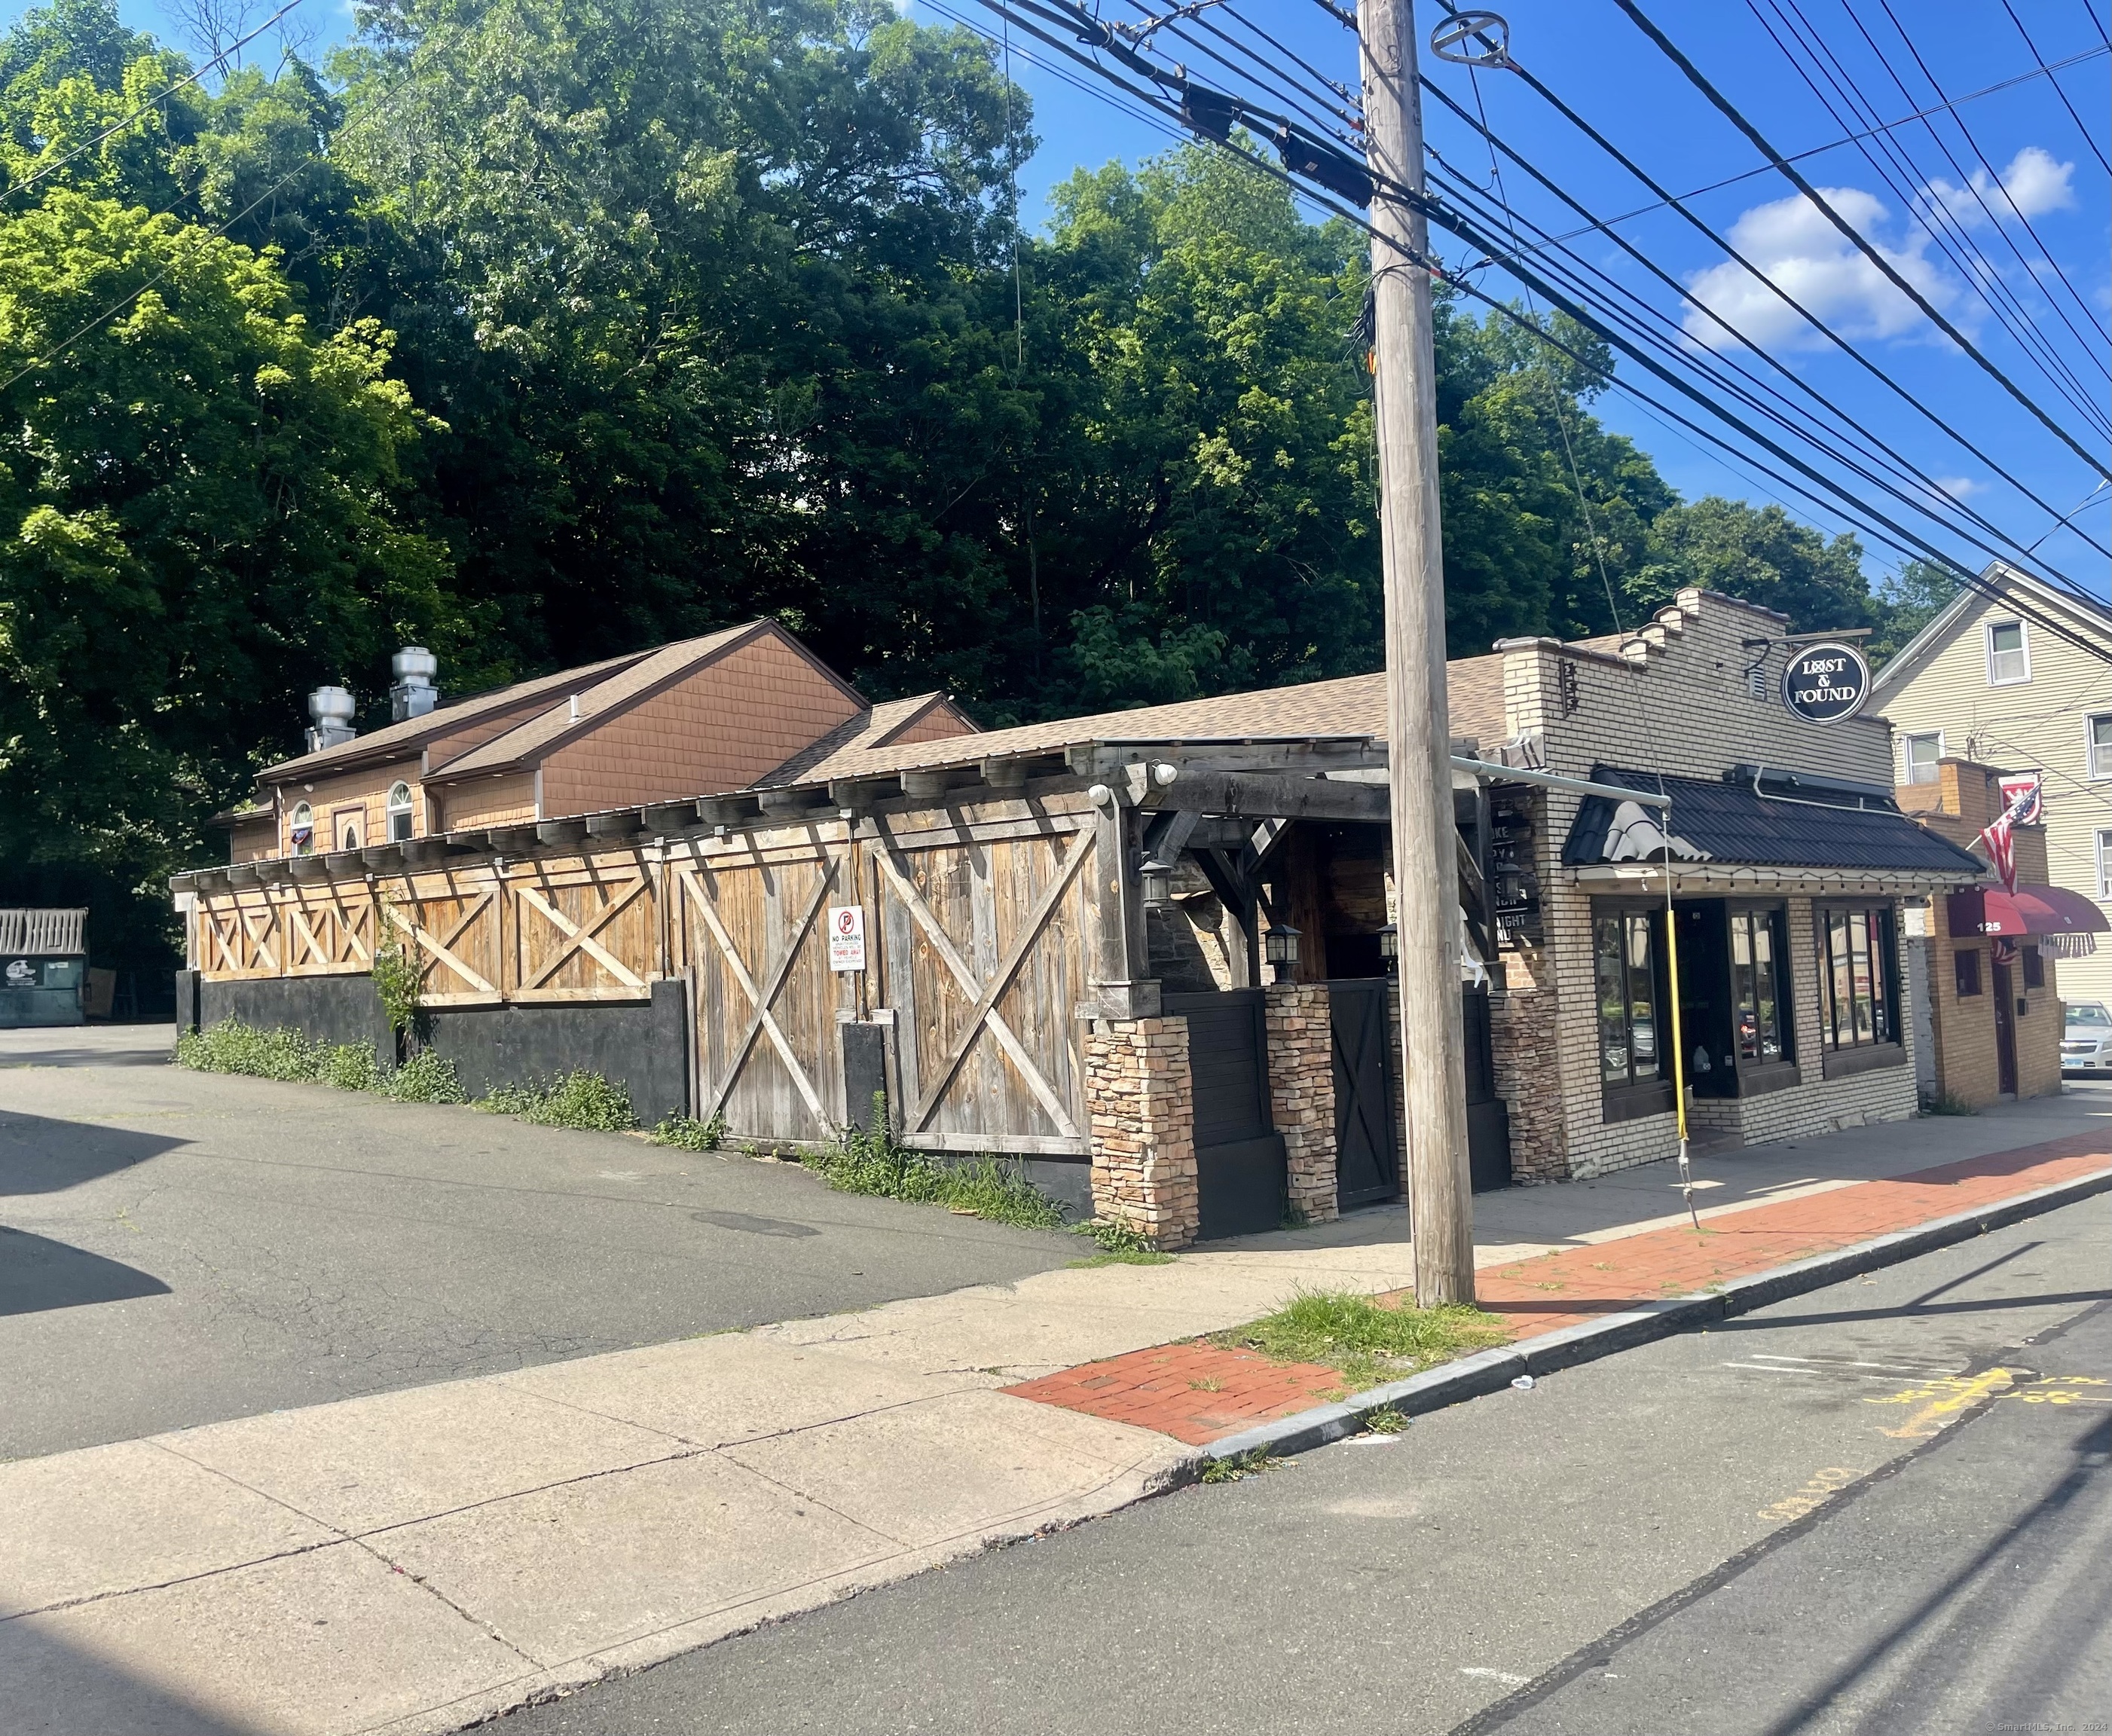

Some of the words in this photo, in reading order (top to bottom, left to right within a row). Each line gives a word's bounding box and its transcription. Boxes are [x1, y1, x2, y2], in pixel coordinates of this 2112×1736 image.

[1802, 658, 1846, 674] LOST
[1818, 674, 1830, 687] &
[1794, 686, 1856, 704] FOUND
[1976, 921, 2001, 932] 125
